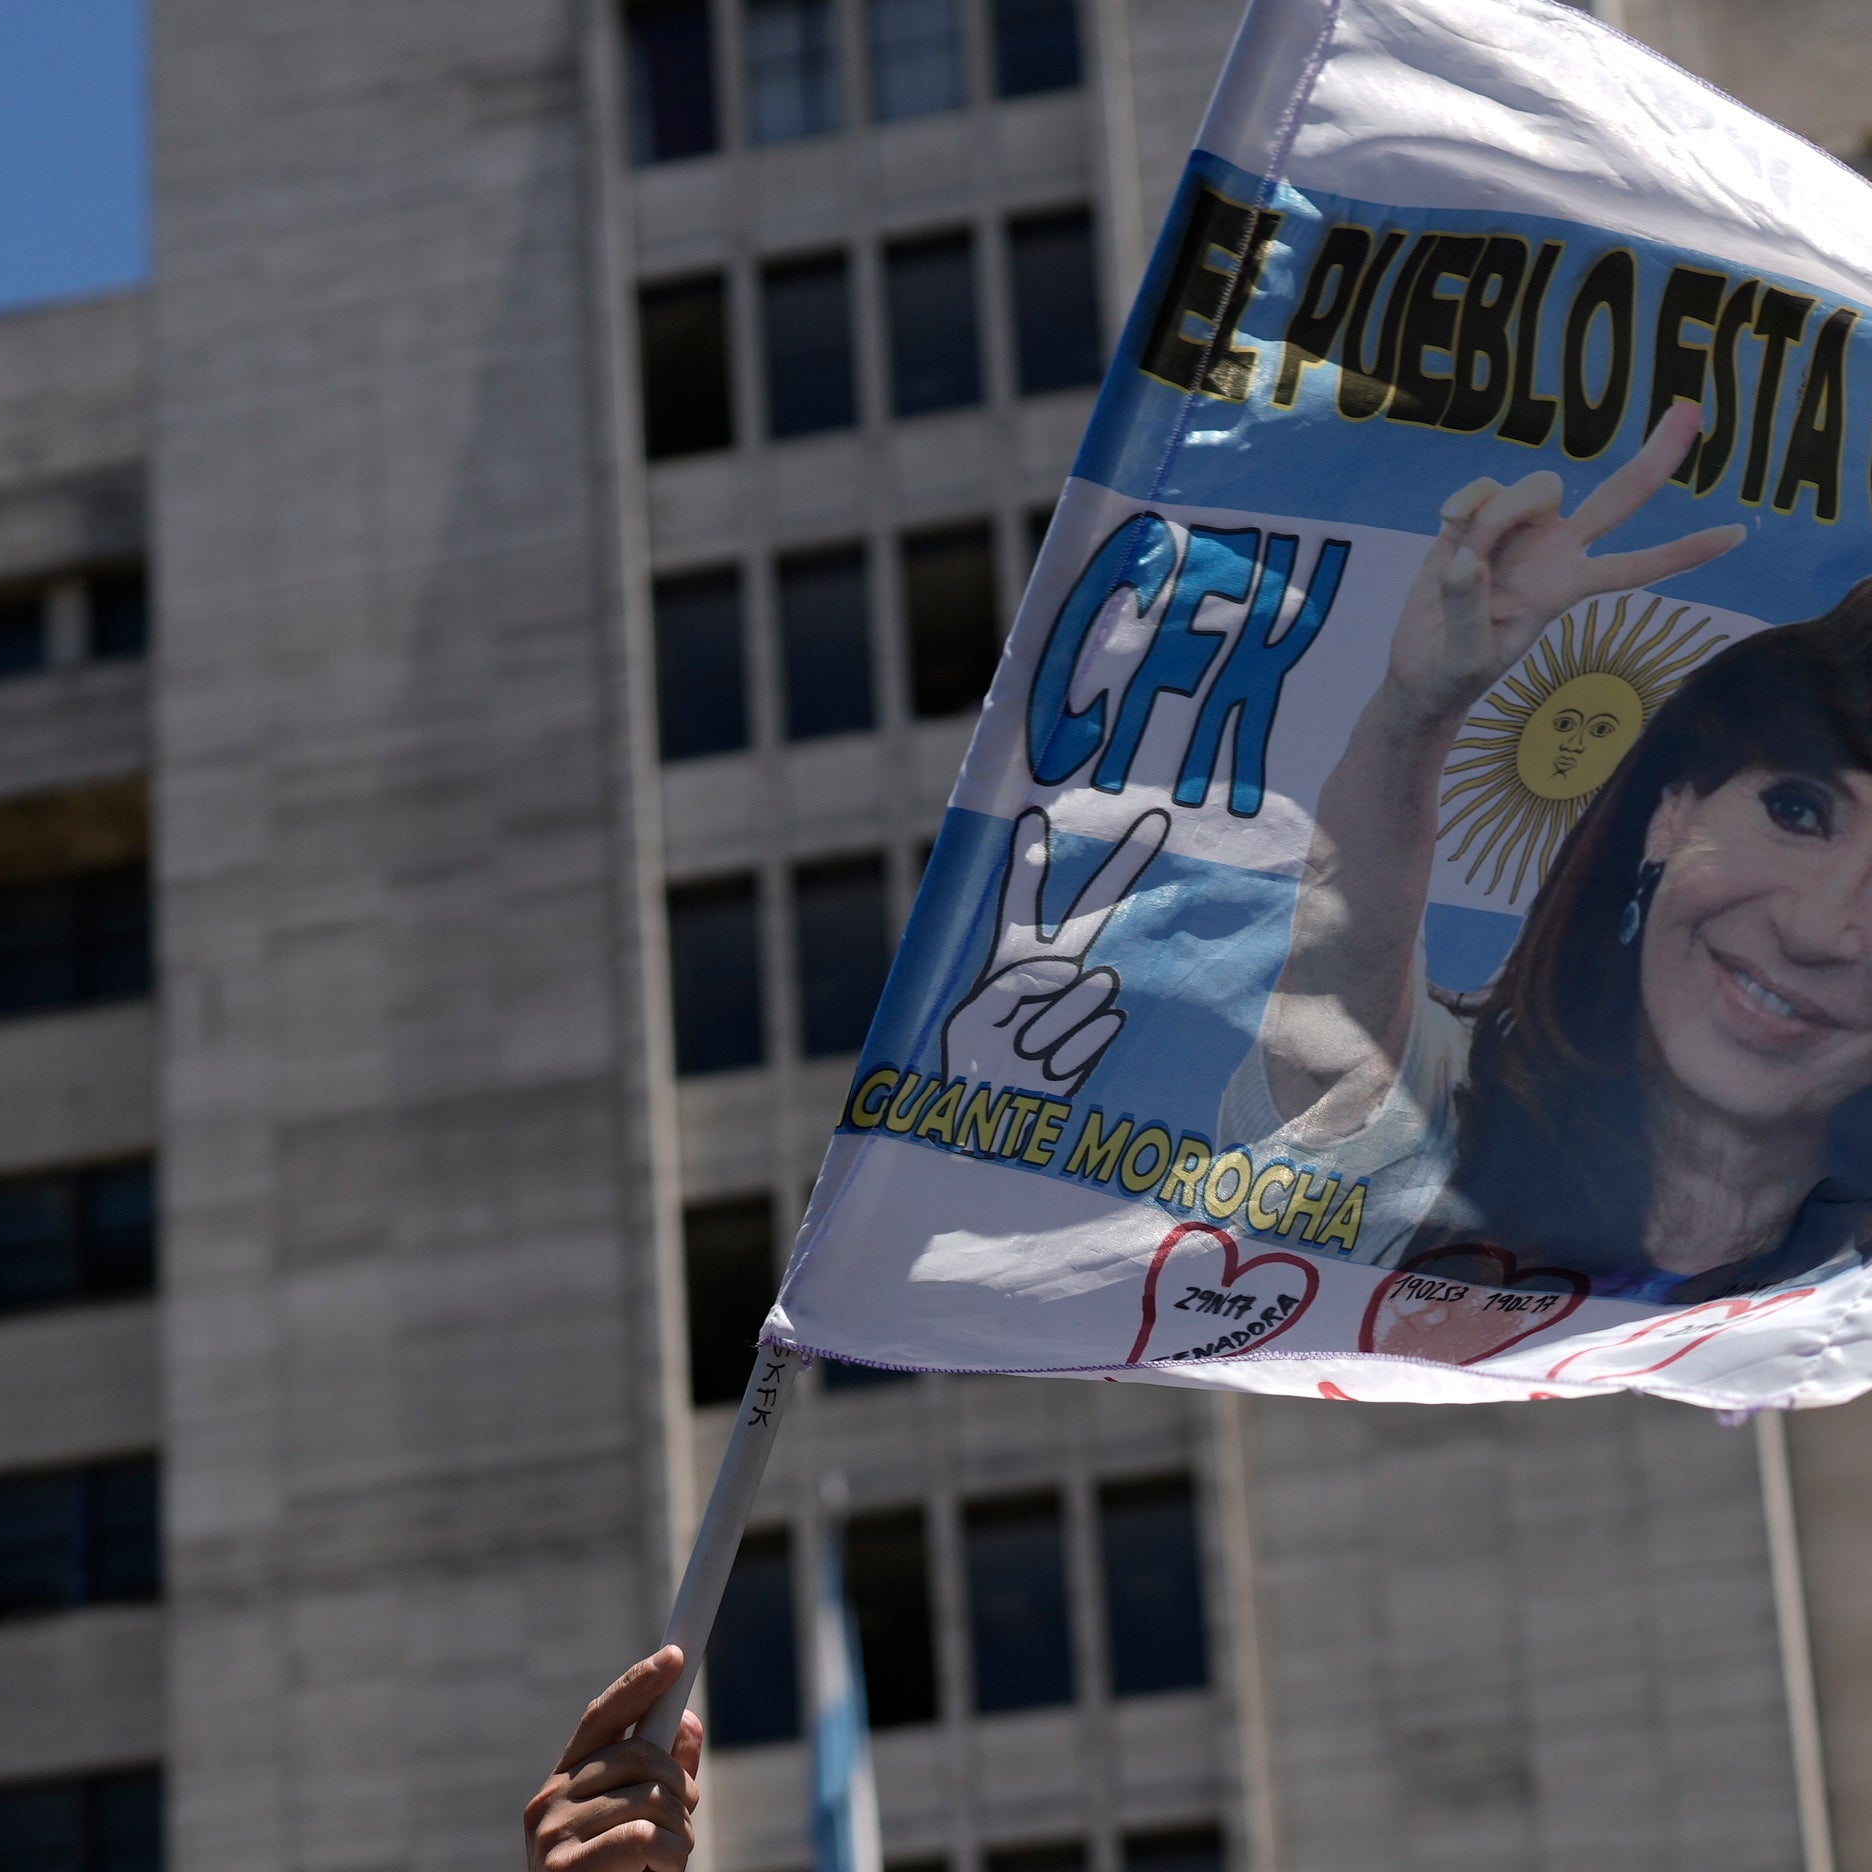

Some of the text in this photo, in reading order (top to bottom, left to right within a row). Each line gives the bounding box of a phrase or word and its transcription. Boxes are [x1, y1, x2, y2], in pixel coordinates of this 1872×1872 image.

[1139, 188, 1285, 404] EL
[1272, 225, 1637, 460] PUEBLO
[1643, 266, 1860, 523] ESTA
[1025, 511, 1351, 817] CFK
[833, 1061, 1370, 1253] GUANTE MOROCHA
[1152, 1293, 1302, 1363] ENADORA
